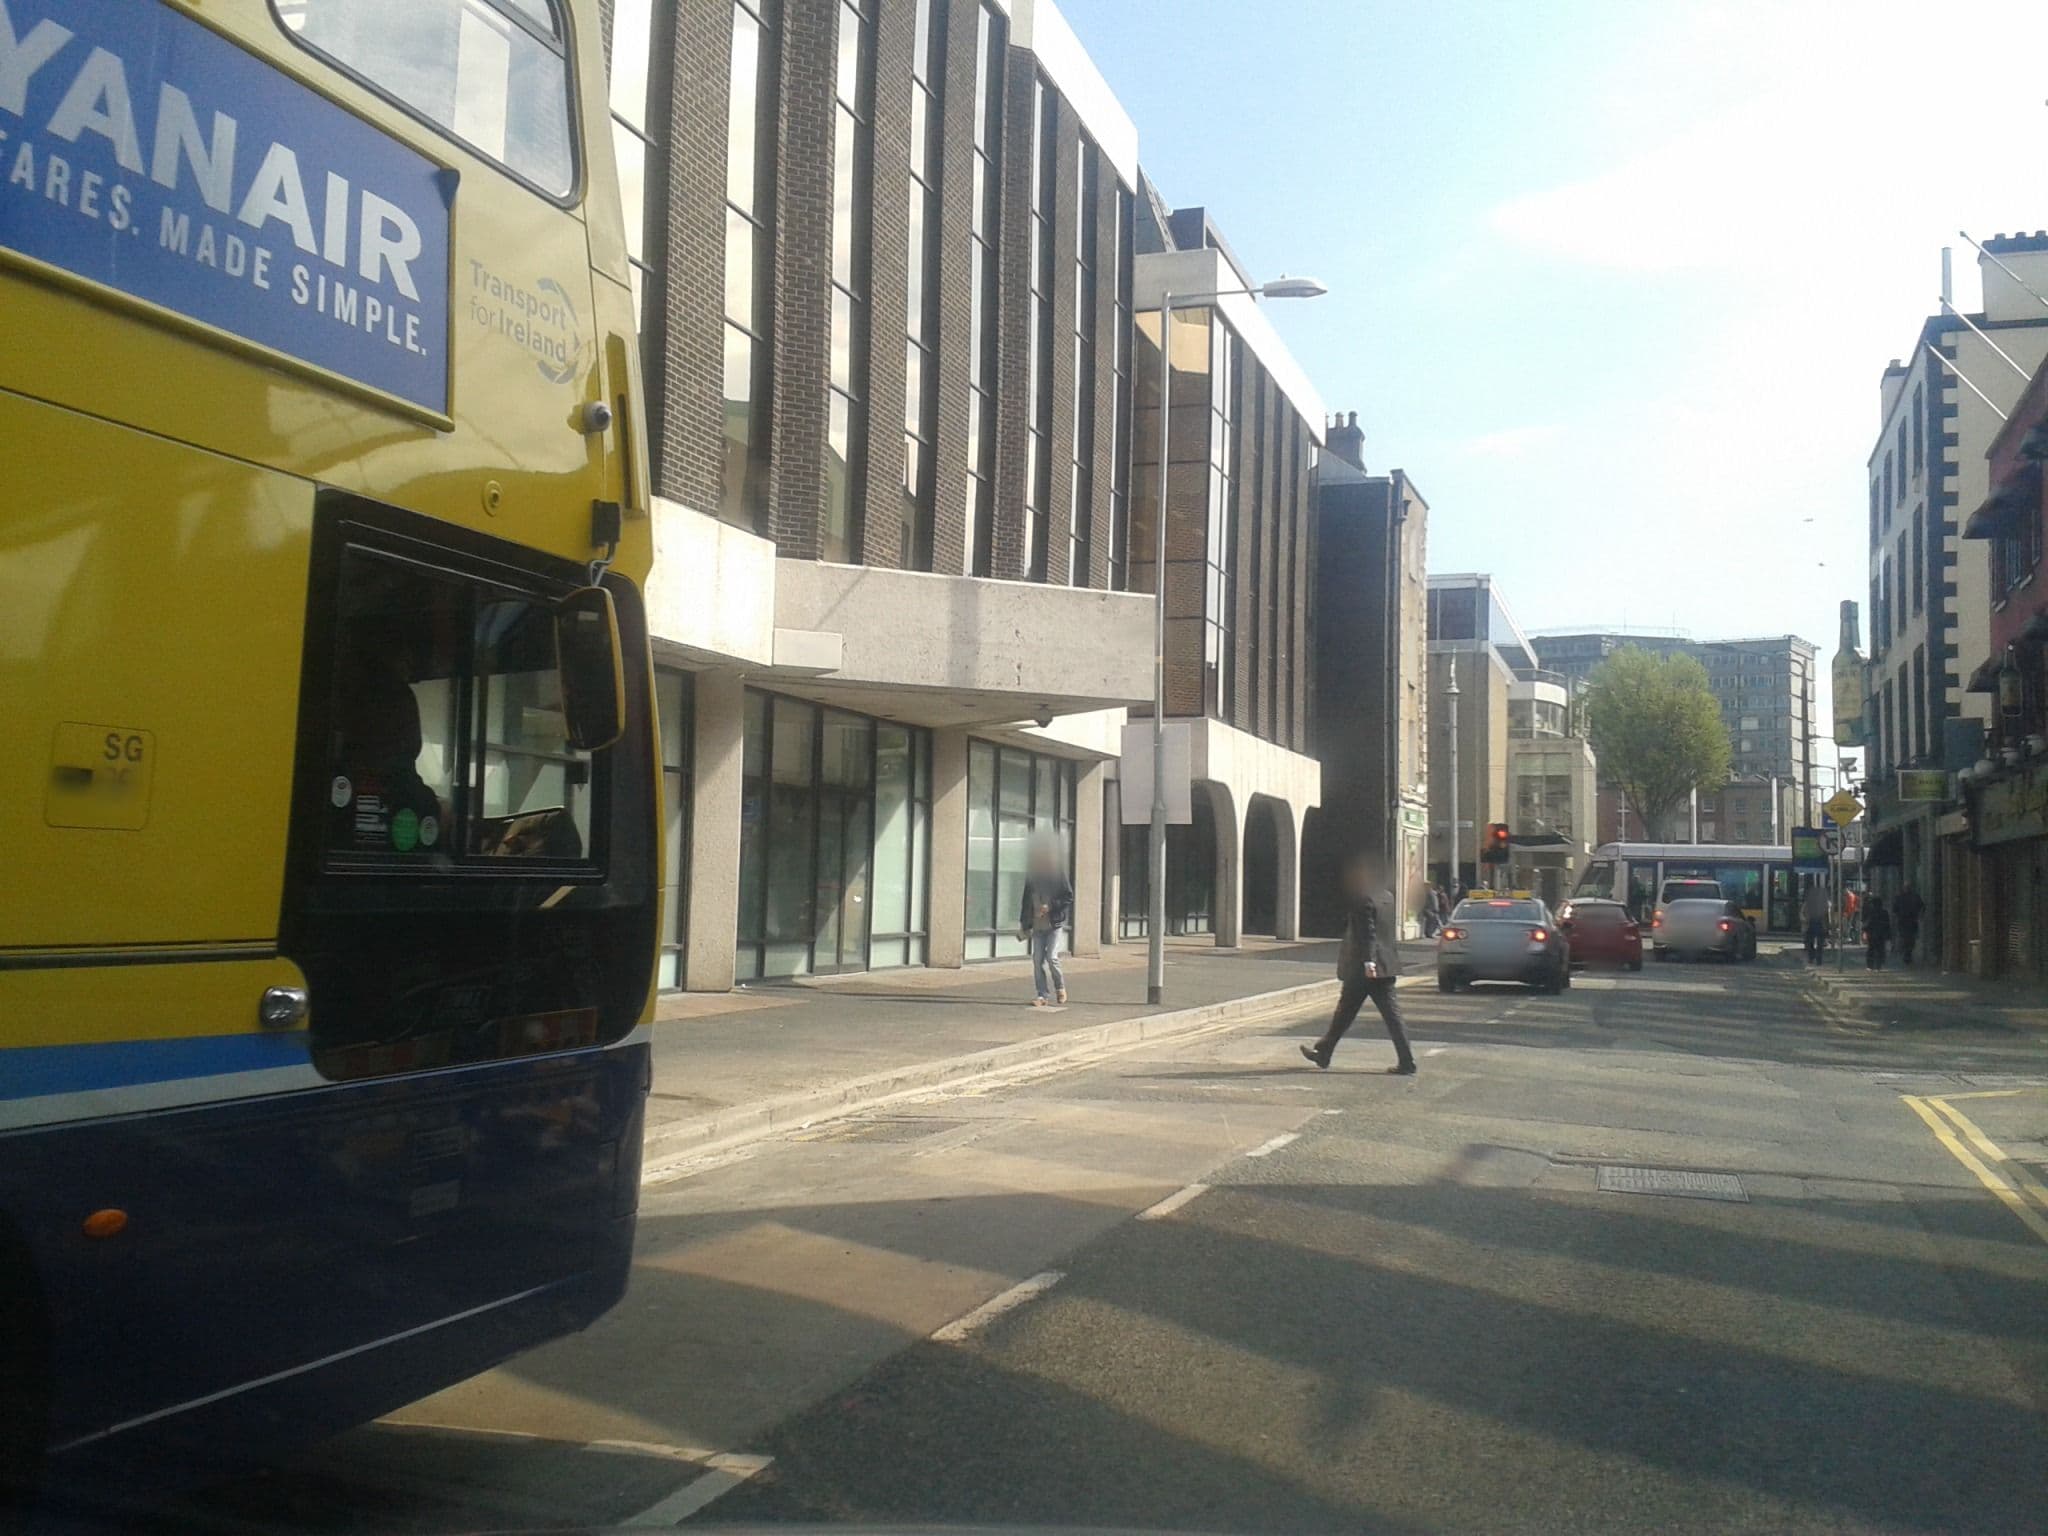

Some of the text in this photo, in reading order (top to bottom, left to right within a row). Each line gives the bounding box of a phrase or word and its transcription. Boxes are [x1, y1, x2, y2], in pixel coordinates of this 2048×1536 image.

[0, 0, 422, 303] YANAIR
[0, 129, 427, 356] ARES. MADE SIMPLE.
[470, 258, 566, 331] Transport
[470, 296, 567, 364] for Ireland
[104, 733, 143, 762] SG
